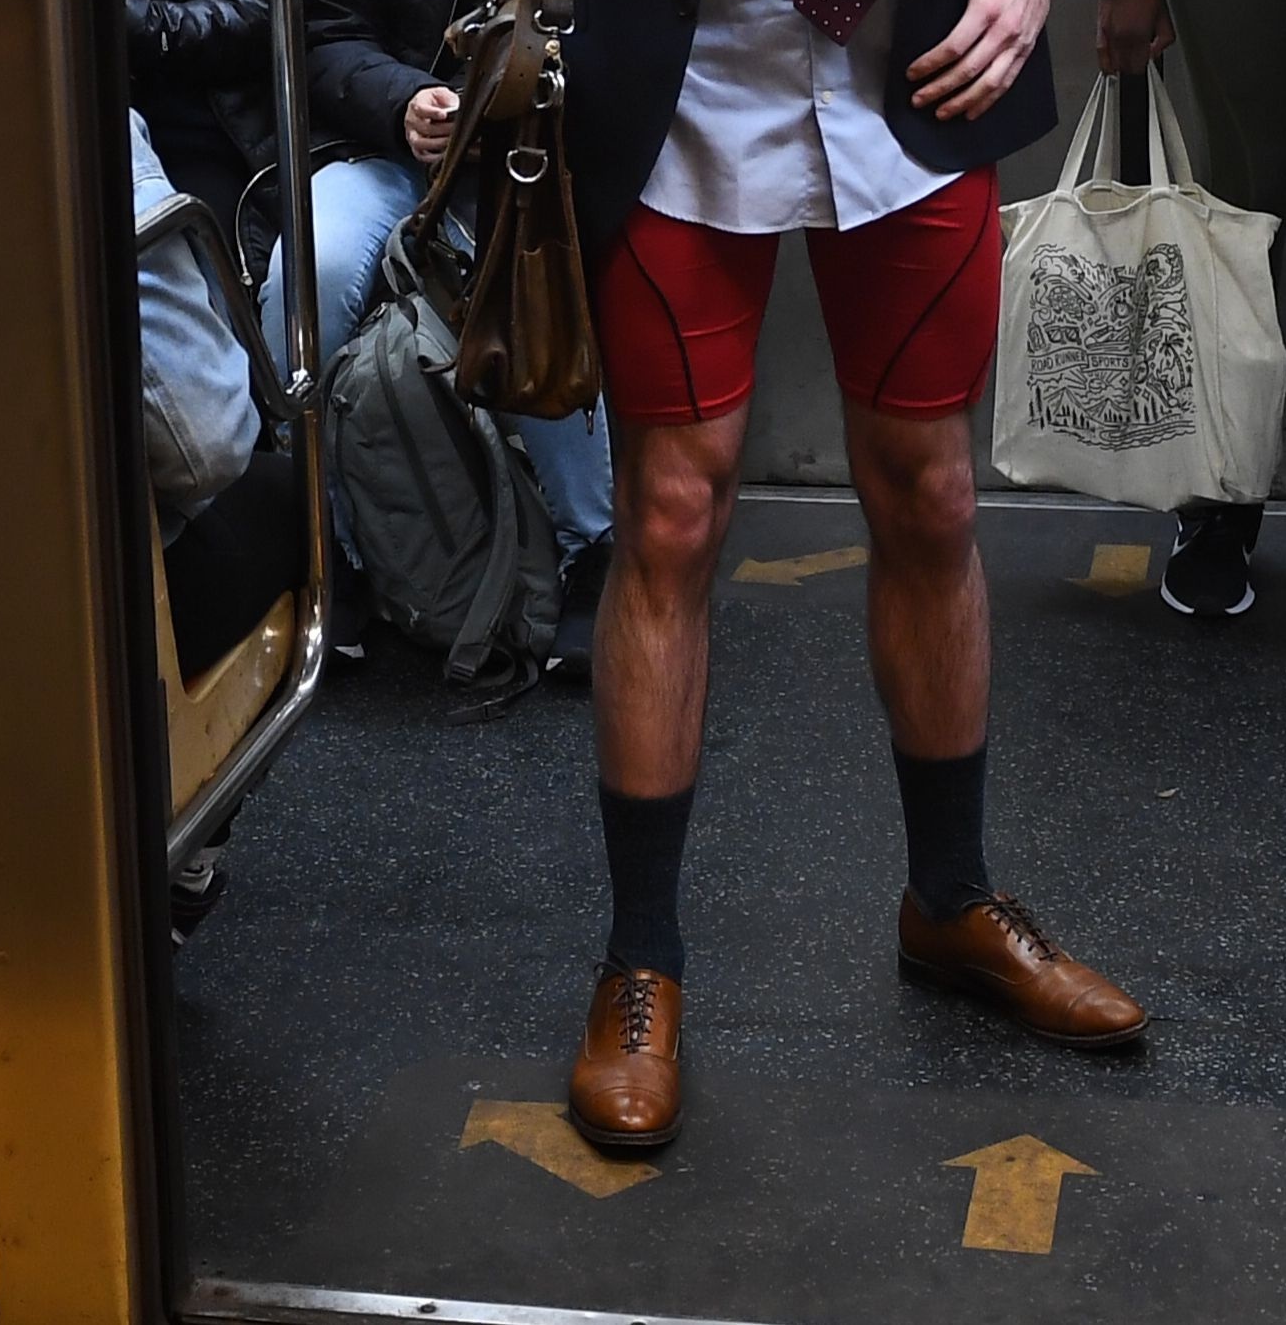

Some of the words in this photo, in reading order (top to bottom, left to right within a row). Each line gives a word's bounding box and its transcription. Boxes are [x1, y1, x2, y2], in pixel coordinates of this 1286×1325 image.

[1031, 357, 1053, 372] ROAD
[1055, 350, 1086, 367] RUNNER
[1092, 356, 1129, 368] SPORTS
